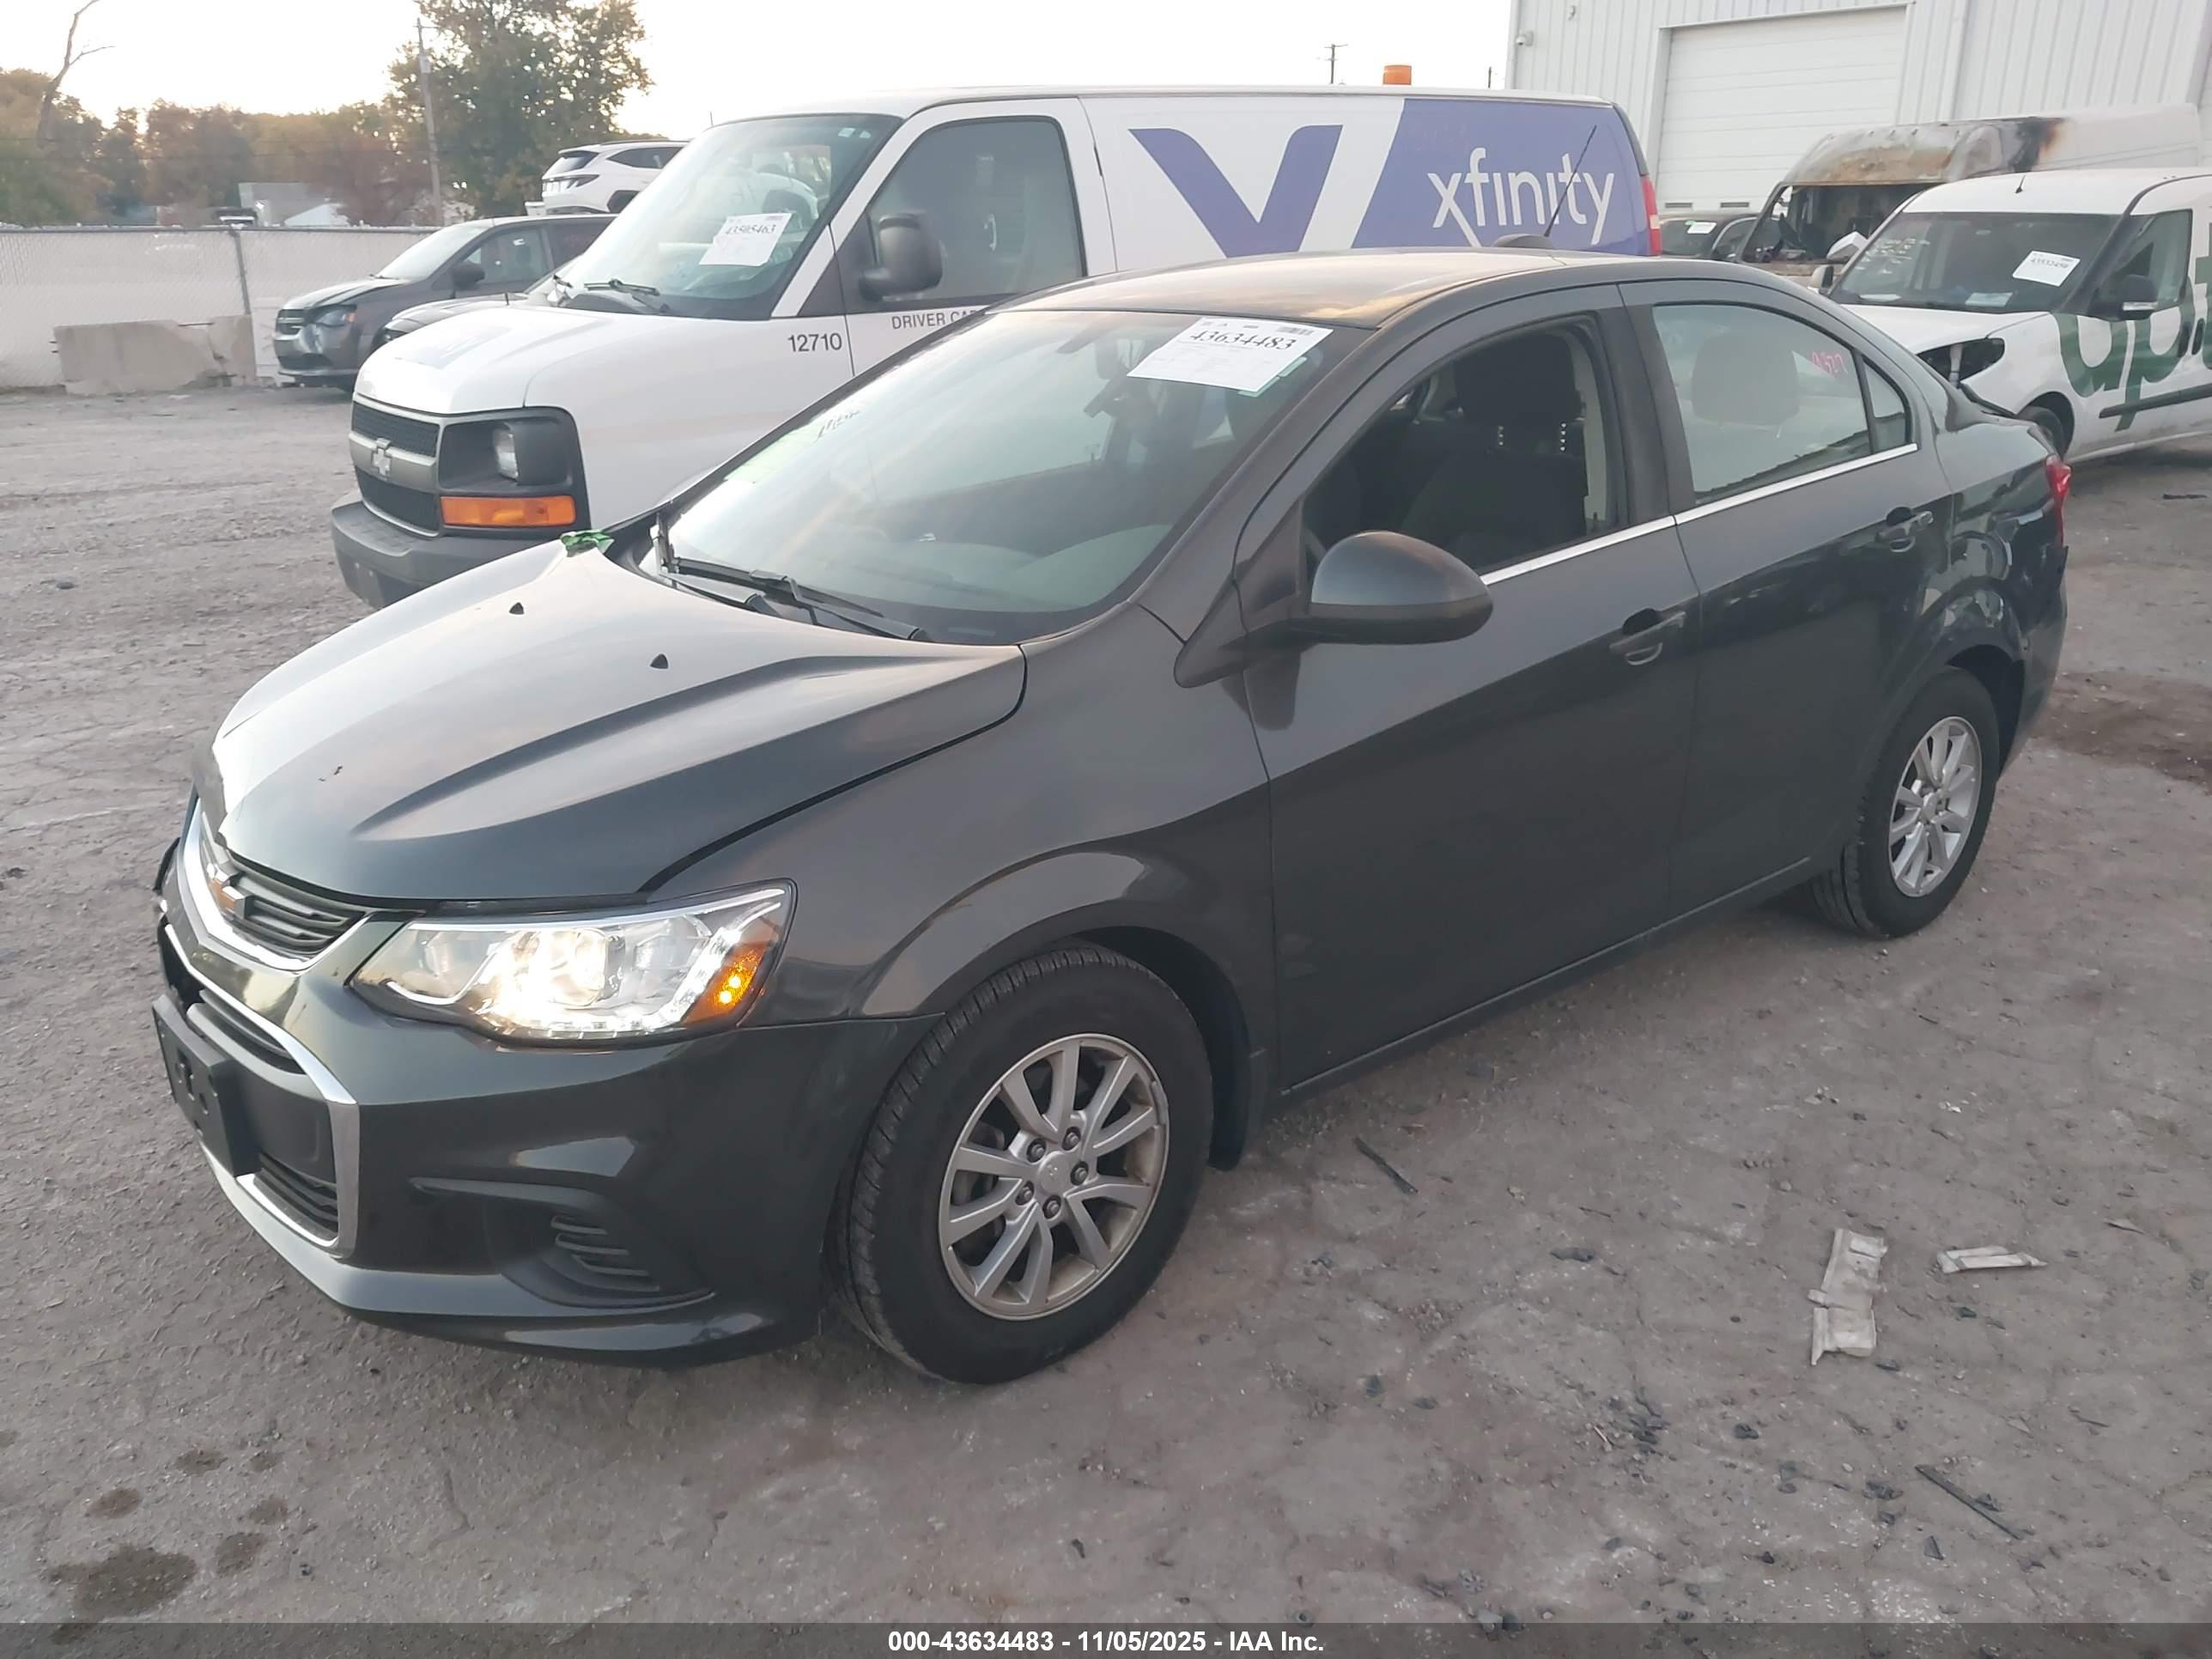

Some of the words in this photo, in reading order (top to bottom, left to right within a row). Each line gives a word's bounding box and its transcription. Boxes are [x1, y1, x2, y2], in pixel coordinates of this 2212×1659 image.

[1427, 147, 1614, 247] xfinity
[891, 313, 946, 330] DRIVER
[787, 332, 842, 353] 12710
[1190, 330, 1297, 350] 43634483
